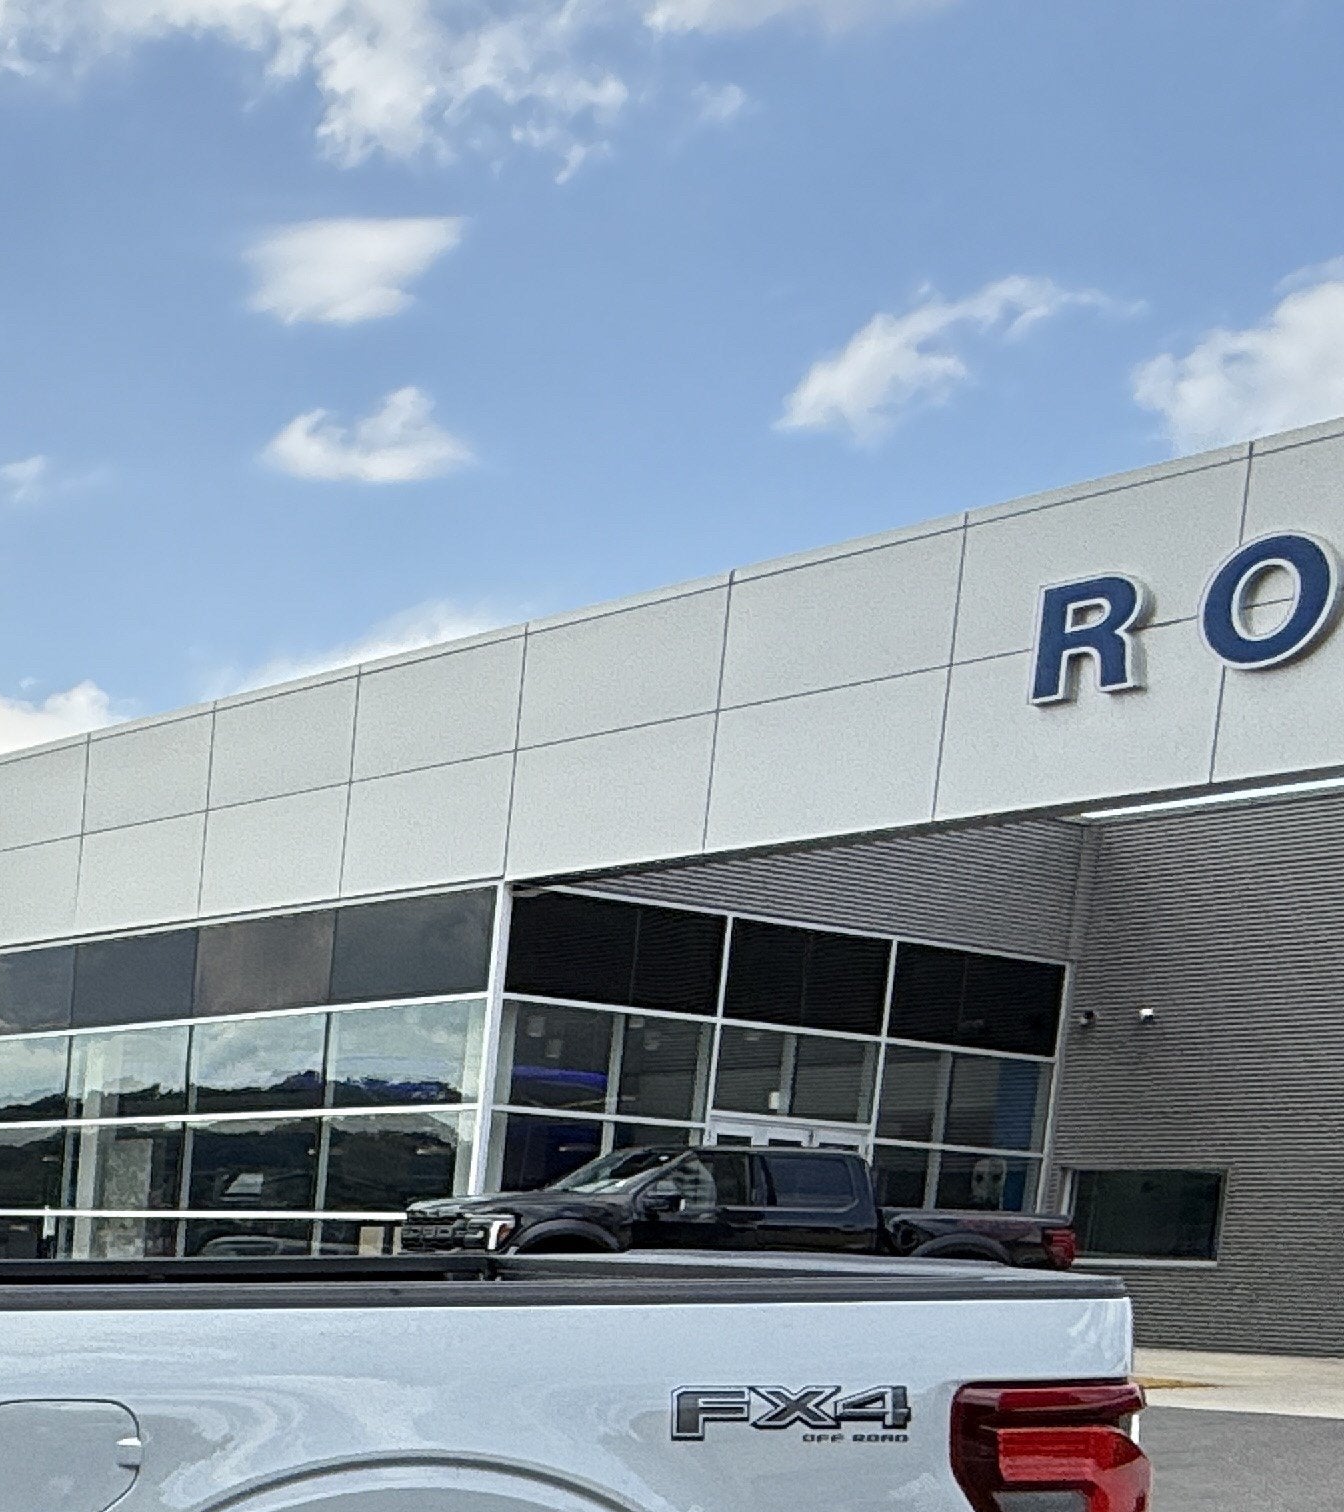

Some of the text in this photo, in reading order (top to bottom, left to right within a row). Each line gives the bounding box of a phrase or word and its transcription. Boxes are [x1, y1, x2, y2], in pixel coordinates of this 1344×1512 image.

[1028, 530, 1340, 706] RO
[671, 1385, 911, 1441] FX4
[802, 1433, 909, 1442] OFF ROAD
